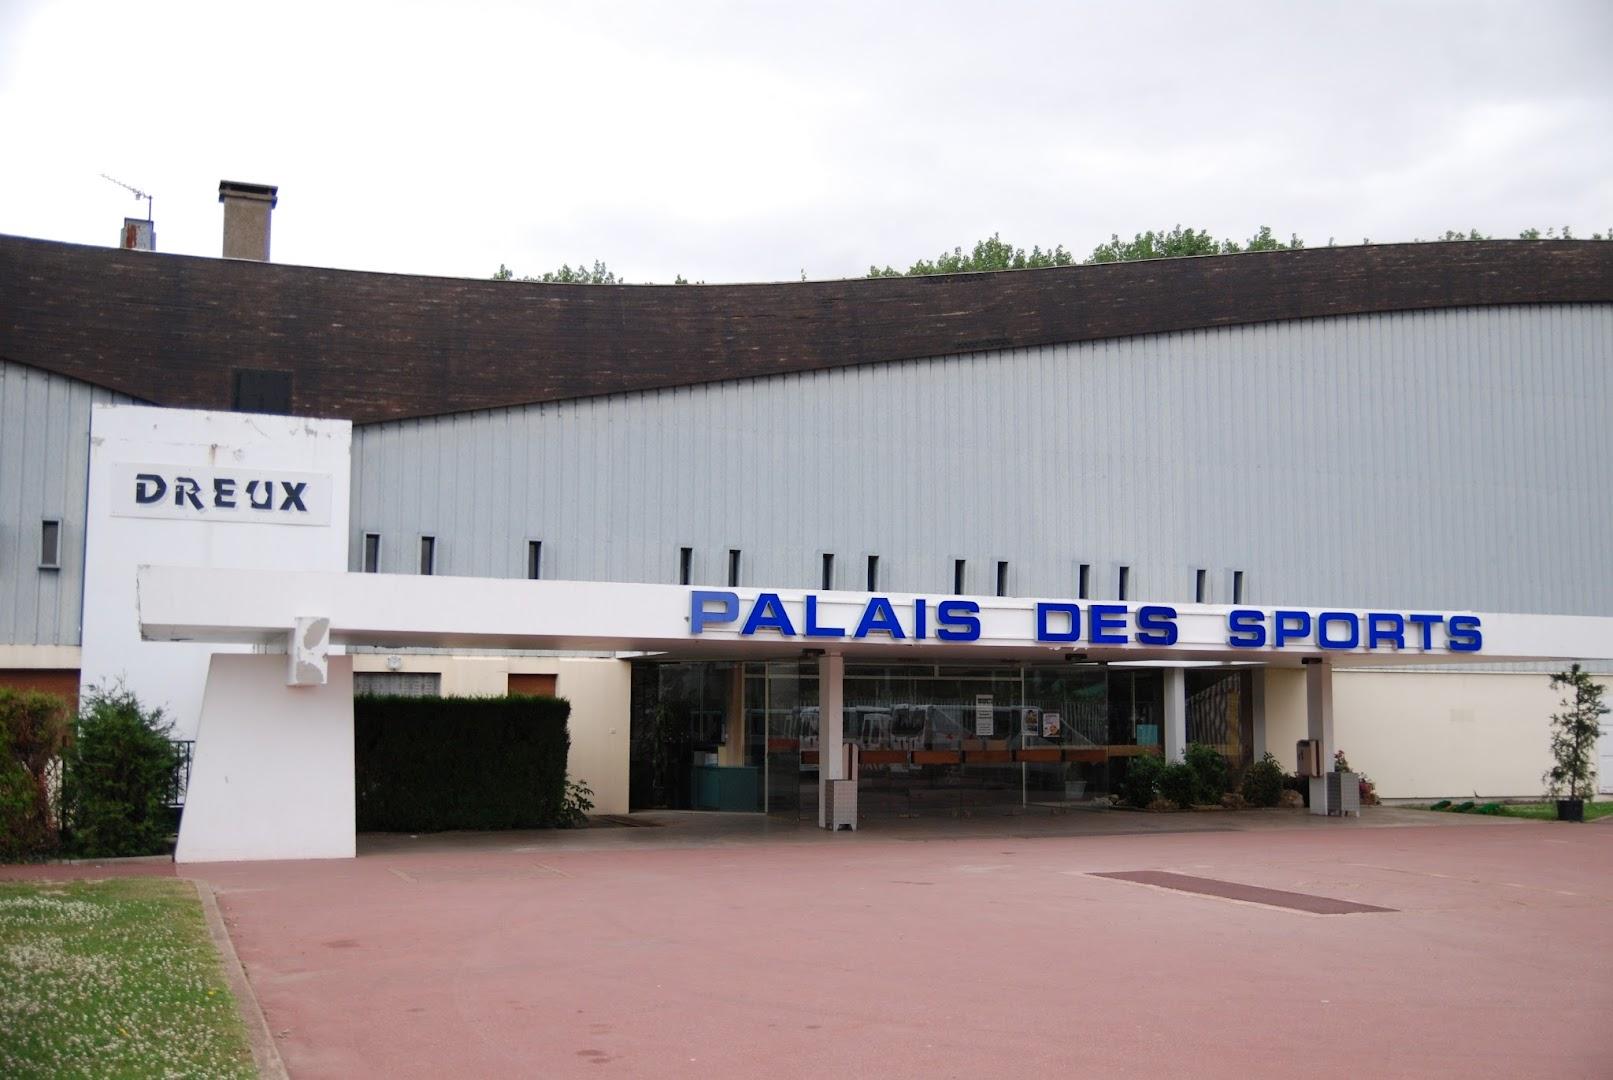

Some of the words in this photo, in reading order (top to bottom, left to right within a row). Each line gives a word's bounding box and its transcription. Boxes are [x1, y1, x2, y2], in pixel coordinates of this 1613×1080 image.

[135, 473, 307, 511] DREUX
[690, 590, 981, 641] PALAIS
[1036, 603, 1178, 645] DES
[1229, 609, 1483, 652] SPORTS
